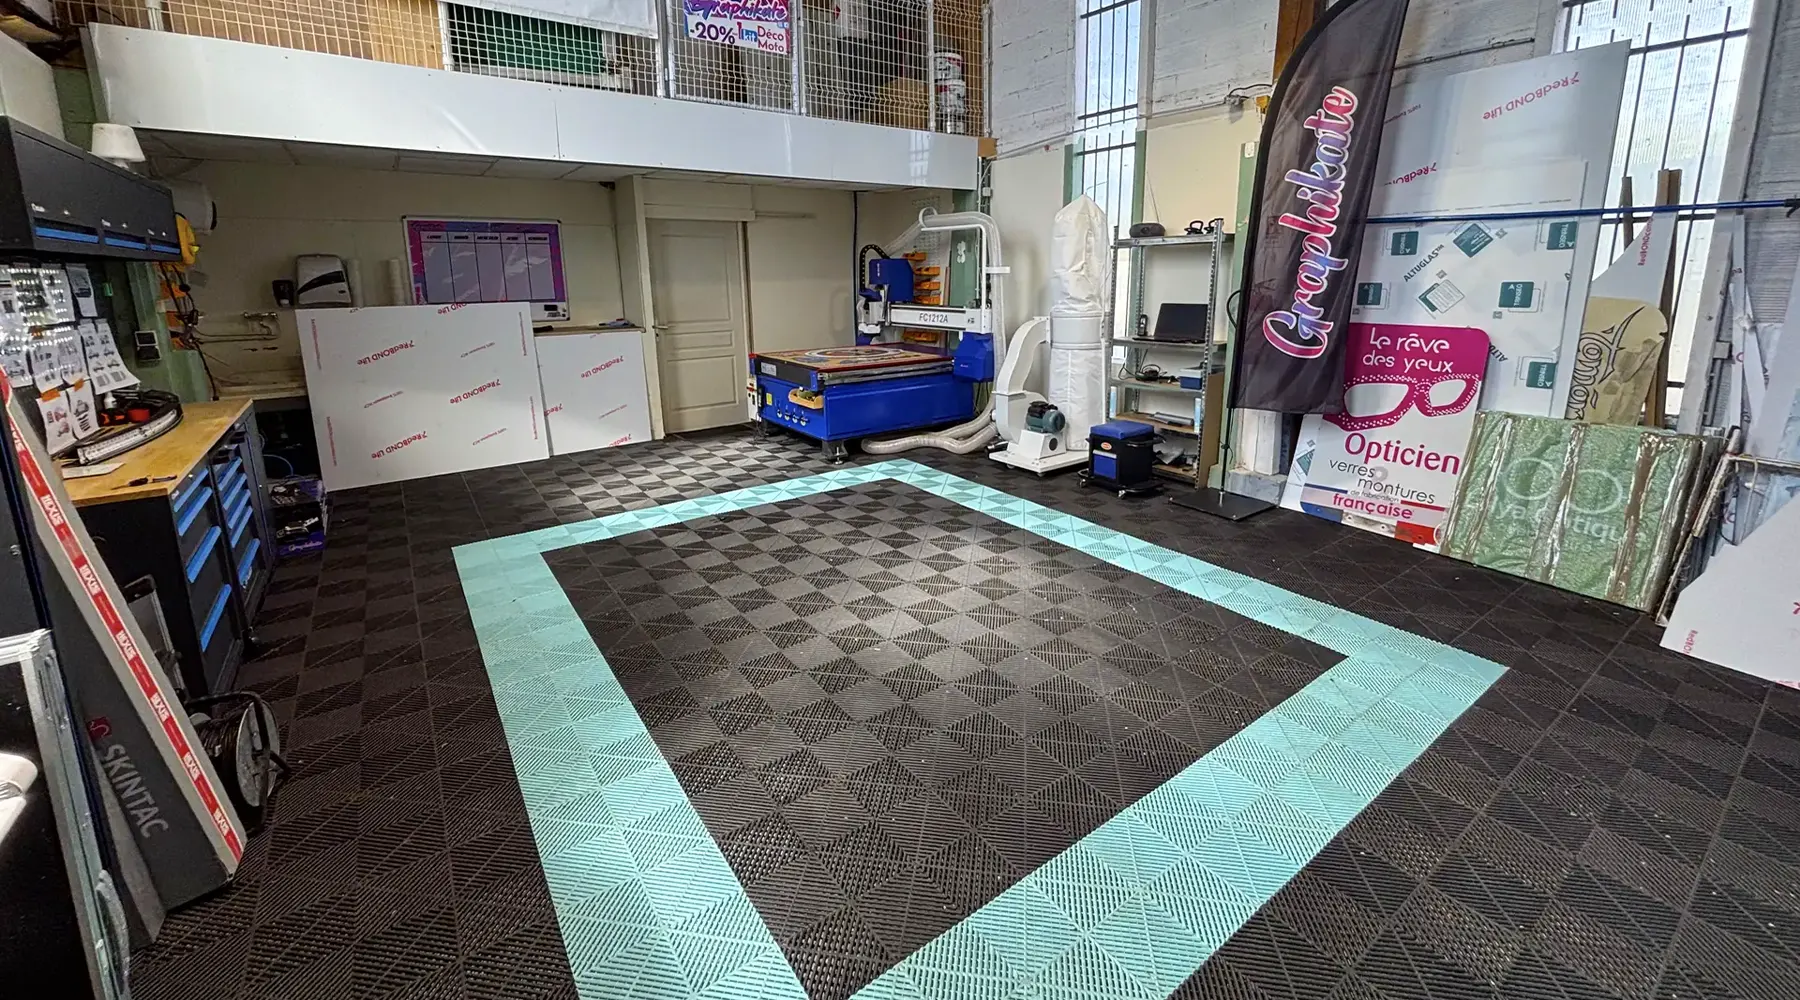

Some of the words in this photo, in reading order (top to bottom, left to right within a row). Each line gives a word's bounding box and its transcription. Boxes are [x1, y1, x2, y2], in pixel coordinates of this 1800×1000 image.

[689, 21, 735, 45] -20%
[743, 29, 756, 42] kit
[757, 25, 784, 41] Déco
[757, 39, 785, 53] Moto
[1263, 86, 1358, 359] Graphikate
[919, 312, 949, 323] FC1212A
[1369, 326, 1391, 350] Le
[1362, 349, 1396, 368] des
[1403, 357, 1454, 374] yeux
[1344, 432, 1461, 475] Opticien
[1329, 459, 1376, 478] verres
[1357, 477, 1436, 504] montures
[1332, 493, 1414, 519] française
[101, 743, 169, 839] SKINTAC
